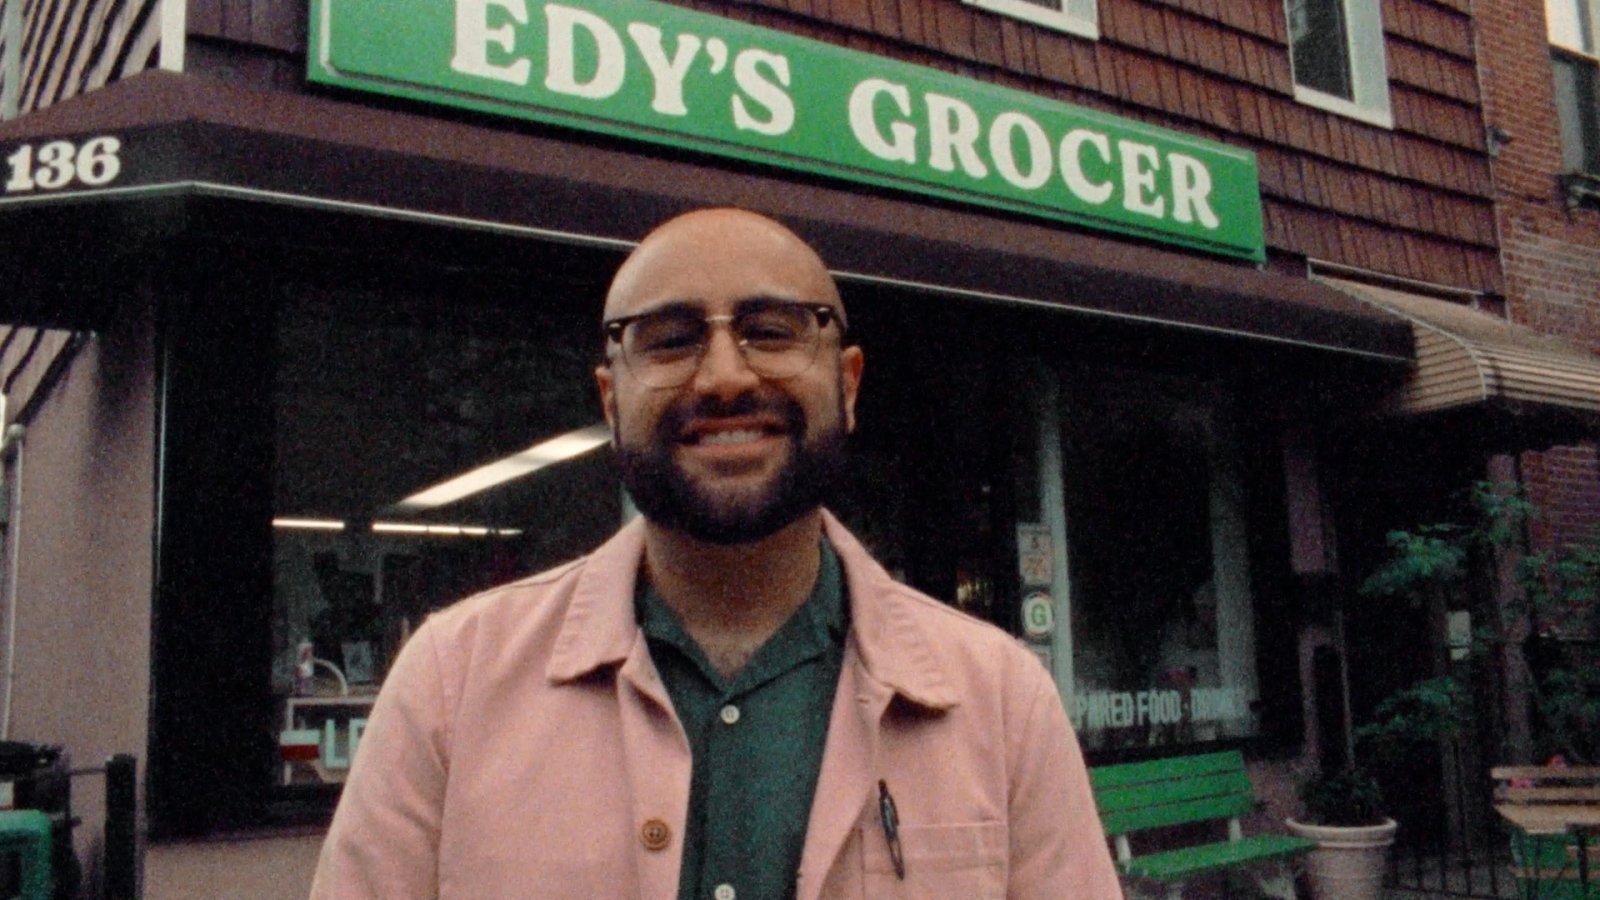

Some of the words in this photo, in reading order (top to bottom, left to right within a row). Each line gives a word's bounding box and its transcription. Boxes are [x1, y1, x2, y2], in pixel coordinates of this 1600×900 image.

[449, 0, 796, 136] EDY'S
[847, 76, 1220, 229] GROCER
[6, 136, 121, 191] 136
[1137, 689, 1182, 726] FOOD
